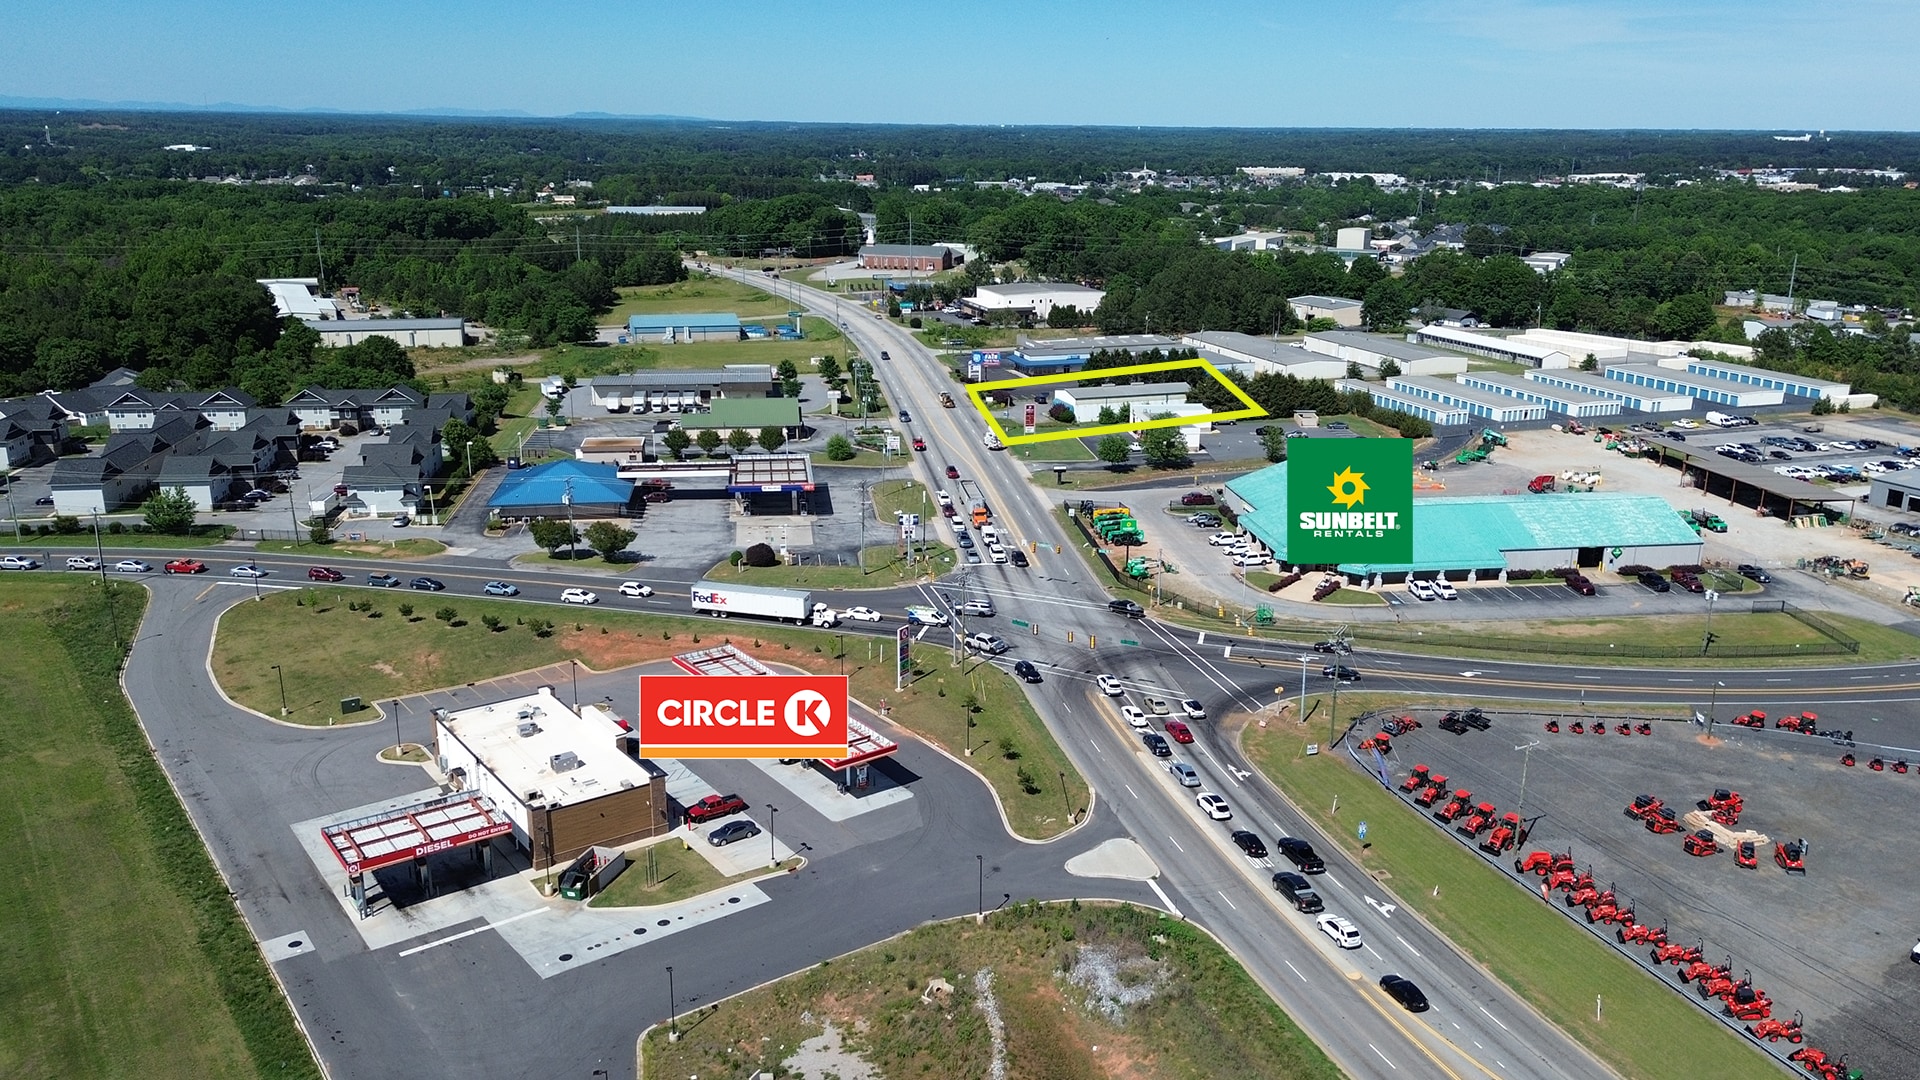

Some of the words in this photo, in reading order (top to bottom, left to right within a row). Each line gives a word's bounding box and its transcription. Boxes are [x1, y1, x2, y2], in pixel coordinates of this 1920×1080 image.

[693, 591, 727, 605] FedEx
[416, 840, 454, 856] DIESEL
[478, 829, 489, 837] NOT
[490, 825, 509, 834] ENTER
